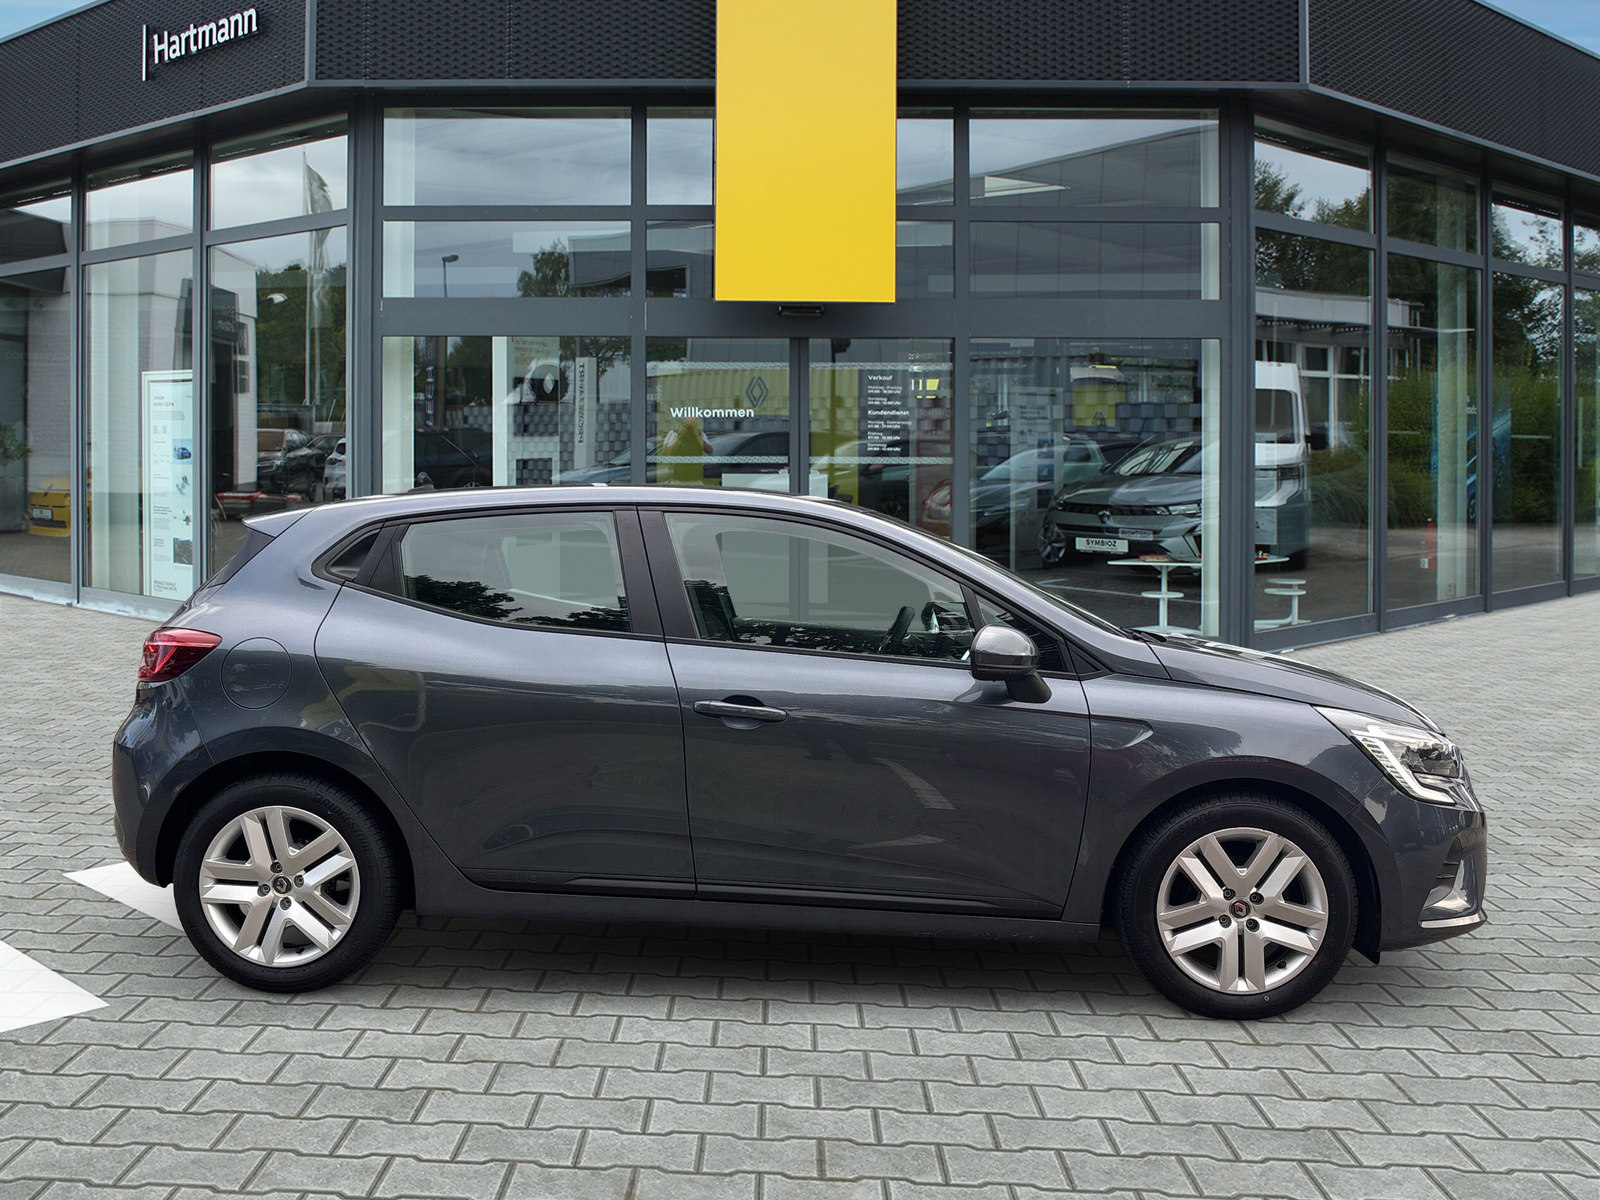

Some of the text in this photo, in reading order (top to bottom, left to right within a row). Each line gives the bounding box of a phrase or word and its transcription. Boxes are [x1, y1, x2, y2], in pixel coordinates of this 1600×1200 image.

[153, 8, 258, 64] Hartmann
[670, 406, 754, 418] Willkommen
[1086, 538, 1117, 547] SYMBIOZ
